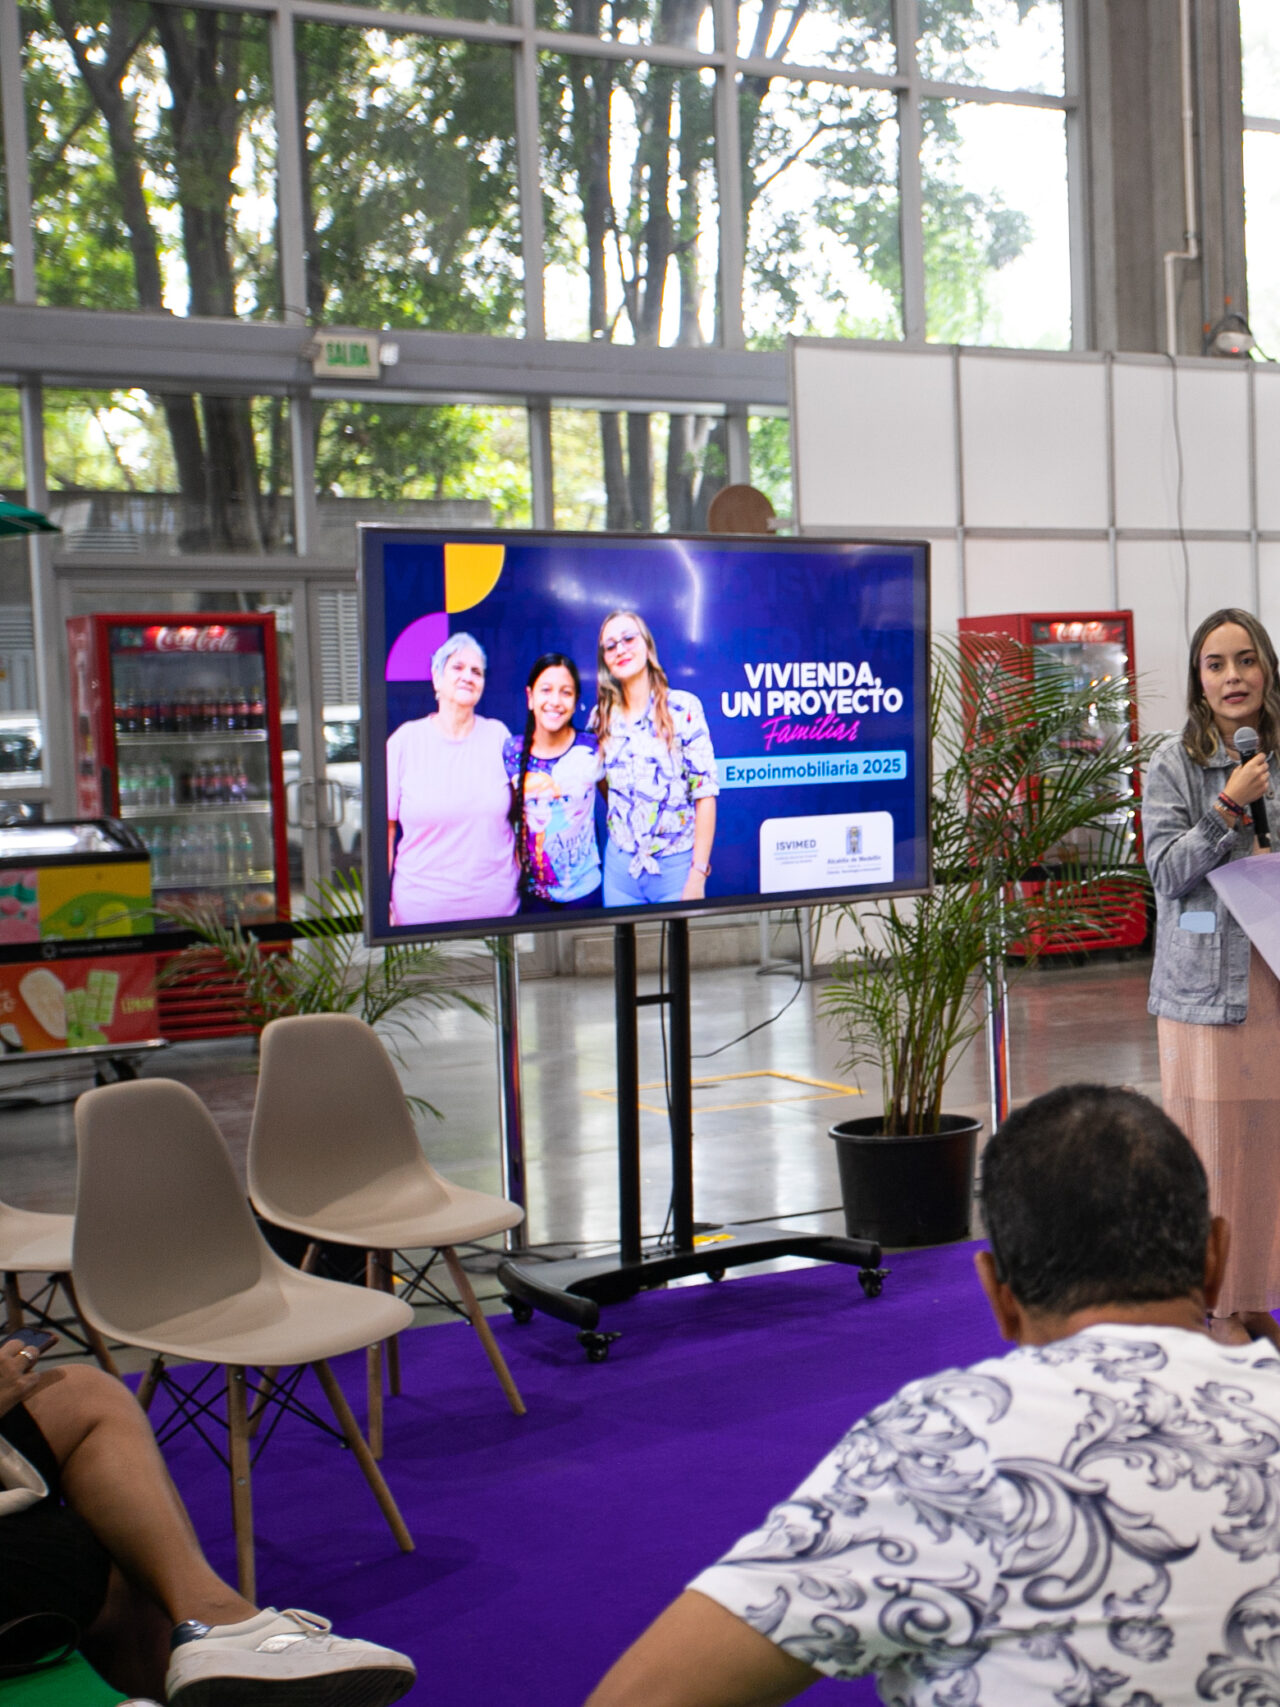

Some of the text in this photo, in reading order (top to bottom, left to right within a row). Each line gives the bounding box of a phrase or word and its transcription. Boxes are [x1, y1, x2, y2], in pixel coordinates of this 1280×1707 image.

[744, 661, 882, 689] VIVIENDA,
[721, 687, 904, 717] UN PROYECTO
[761, 710, 860, 751] Familiar
[725, 758, 902, 784] Expoinmobiliaria 2025
[776, 839, 817, 851] ISVIMED
